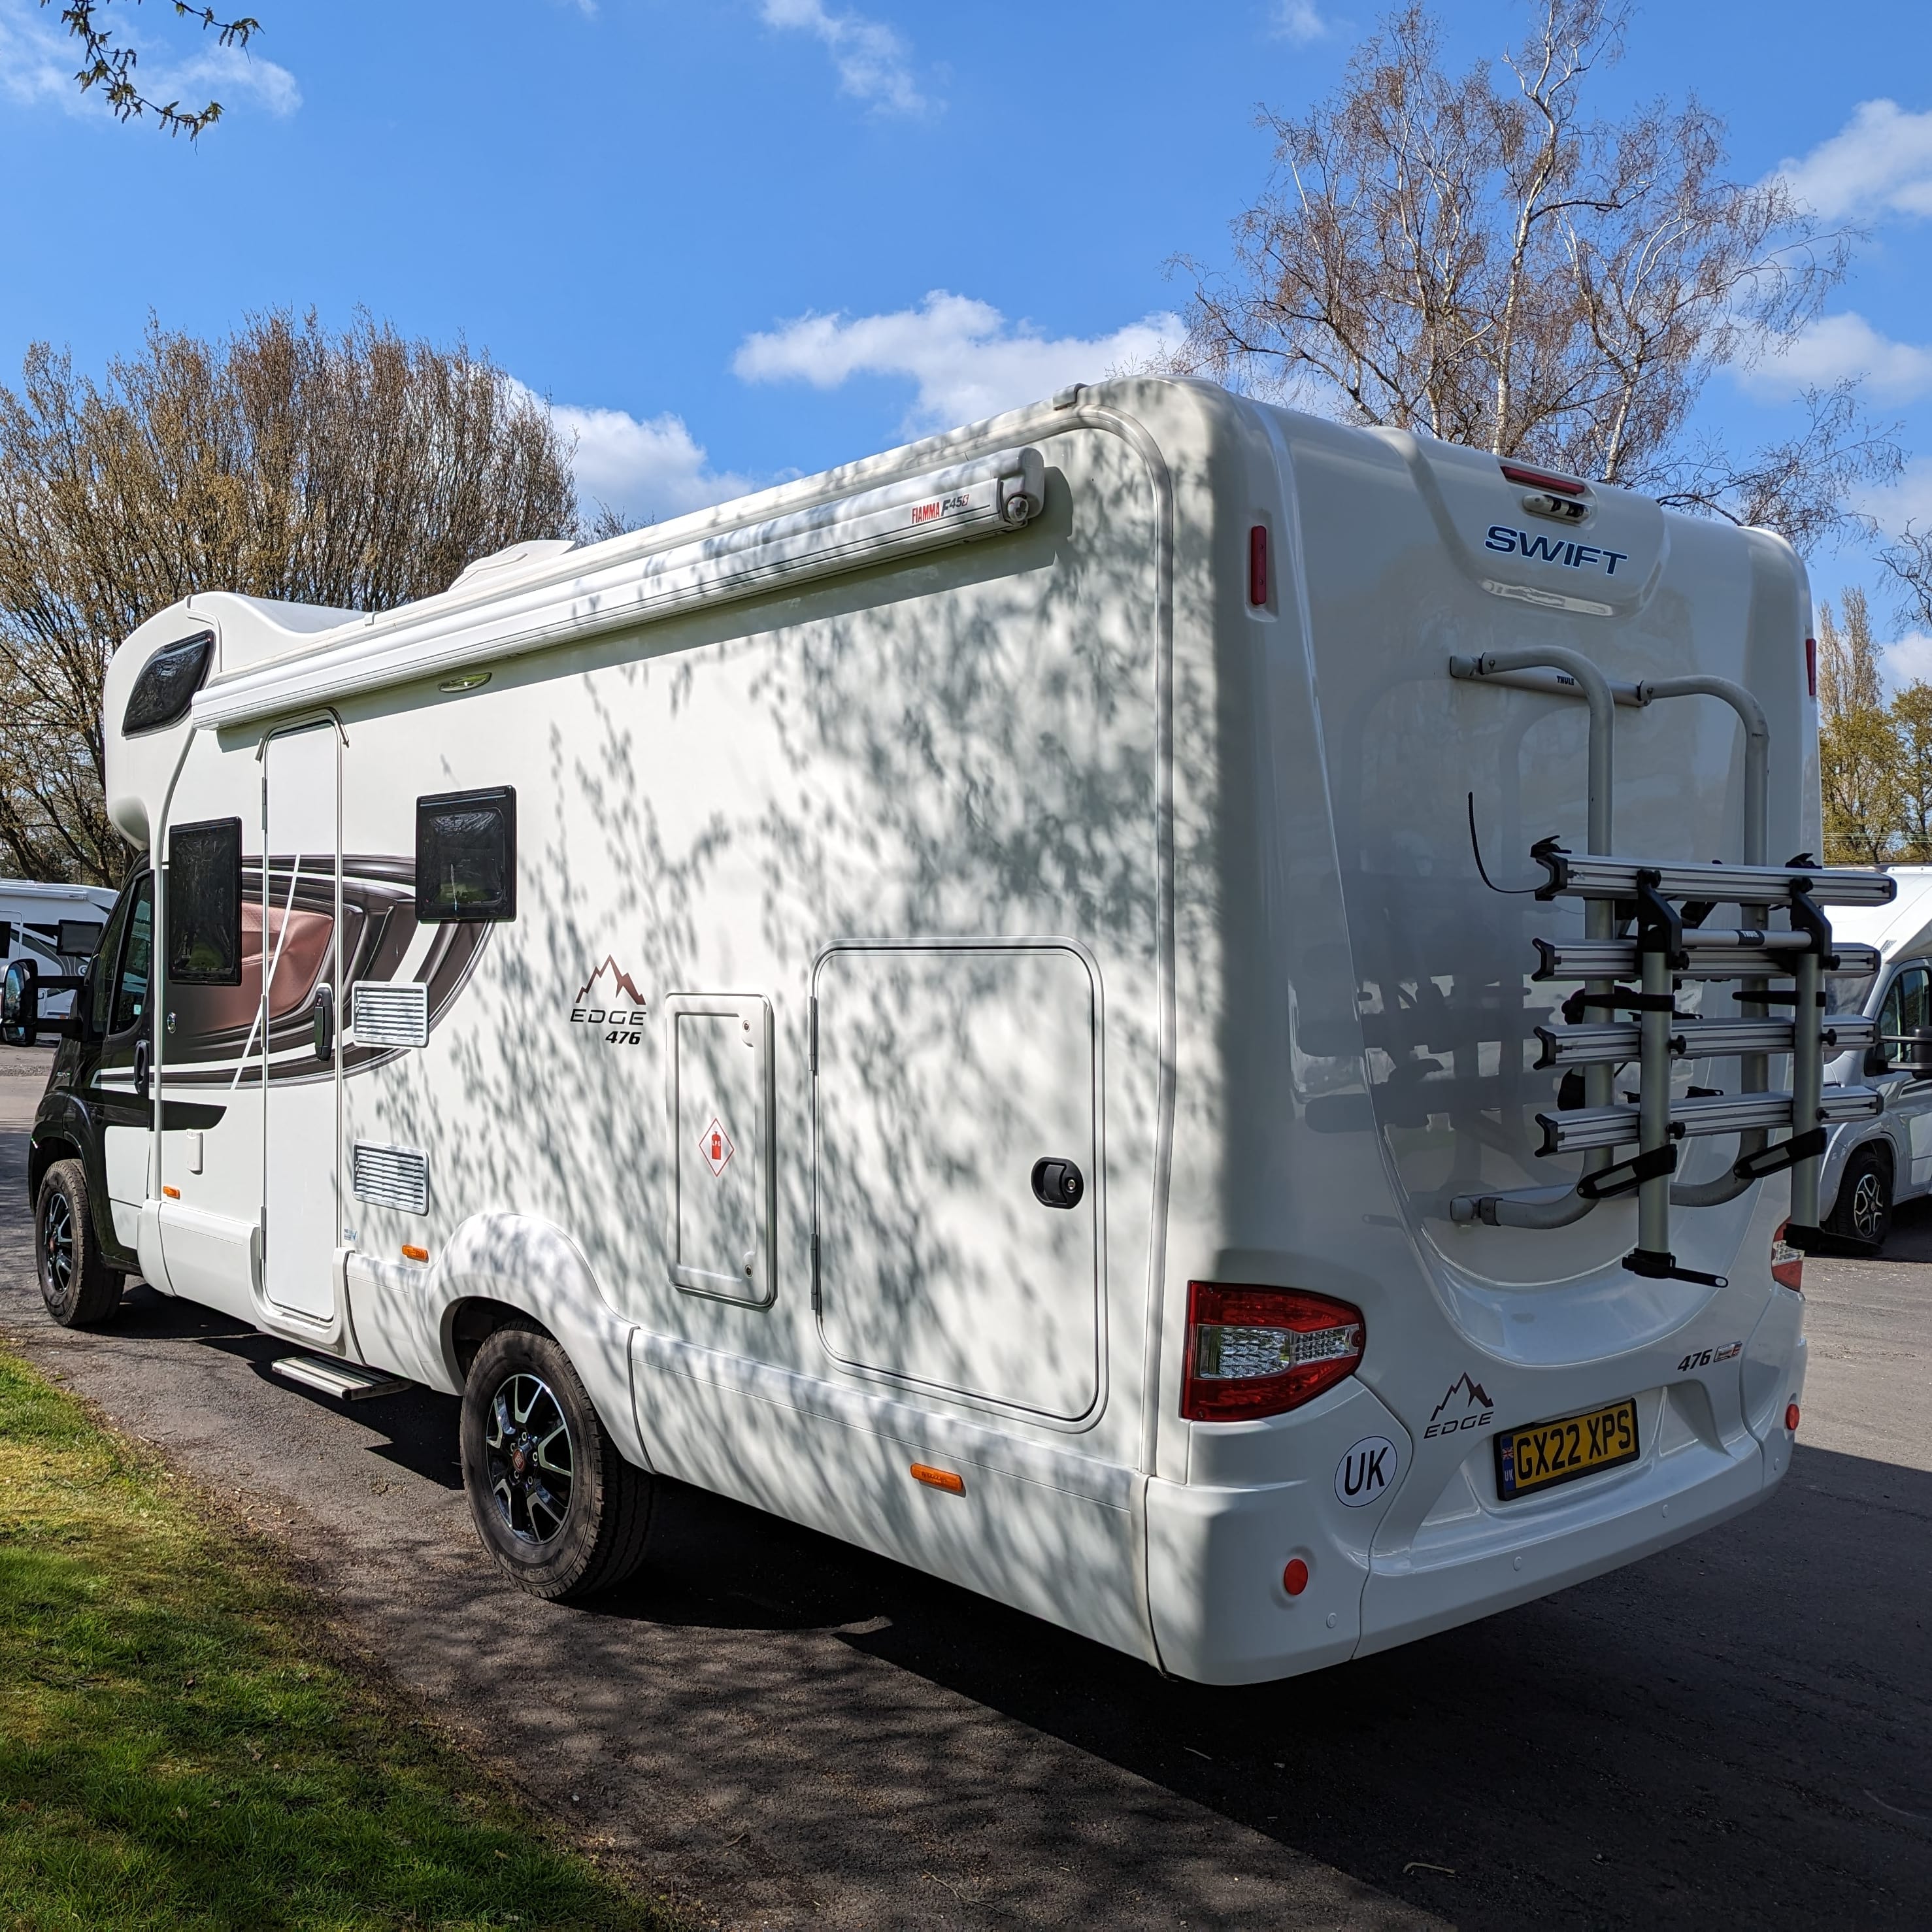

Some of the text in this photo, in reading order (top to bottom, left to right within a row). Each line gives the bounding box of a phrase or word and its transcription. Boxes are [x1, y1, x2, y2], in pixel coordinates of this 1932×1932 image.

[911, 501, 941, 525] FIAMMA
[1484, 525, 1629, 576] SWIFT
[1556, 675, 1574, 686] THULE
[570, 1008, 647, 1026] EDGE
[605, 1031, 642, 1045] 476
[1677, 1348, 1713, 1372] 476
[1423, 1411, 1495, 1439] EDGE
[1516, 1408, 1631, 1481] GX22 XPS
[1344, 1446, 1389, 1496] UK
[1504, 1468, 1514, 1482] UK
